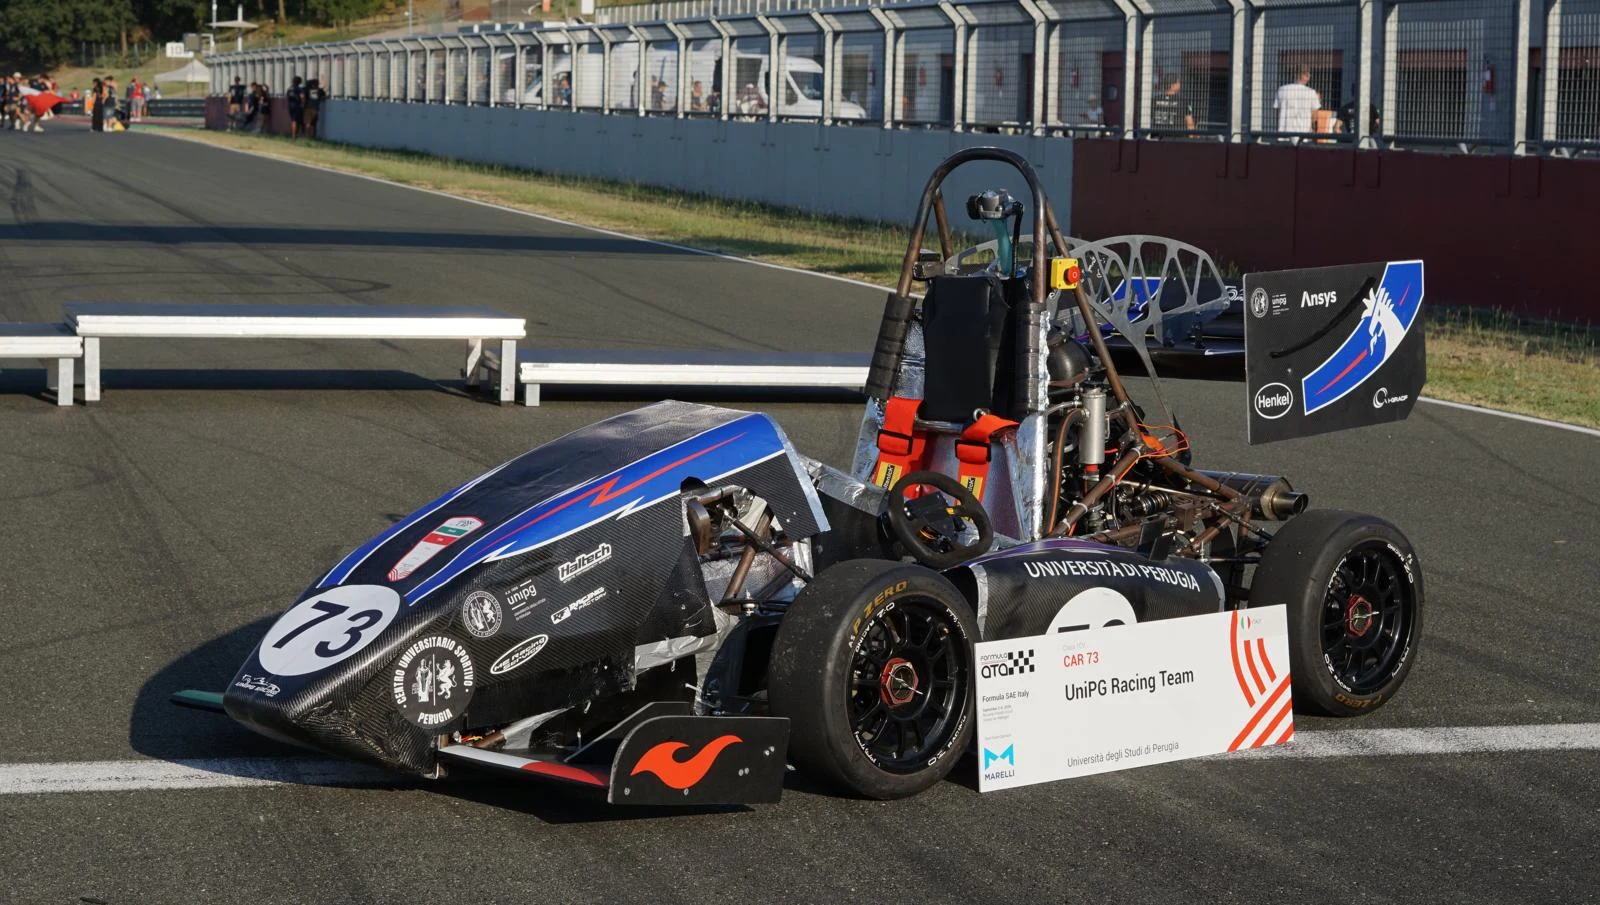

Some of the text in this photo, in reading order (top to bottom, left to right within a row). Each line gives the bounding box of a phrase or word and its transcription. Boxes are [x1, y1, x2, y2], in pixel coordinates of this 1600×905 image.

[1300, 290, 1337, 308] Ansys
[1258, 392, 1290, 409] Henkel
[558, 543, 612, 581] Haltech
[1024, 559, 1201, 592] UNIVERSITÀ DI PERUGIA
[507, 584, 537, 605] unipg
[853, 580, 908, 636] P ZERO
[272, 600, 383, 658] 73
[393, 636, 474, 705] CENTRO UNIVERSITARIO SPORTIVO
[1063, 651, 1099, 667] CAR 73
[982, 689, 1030, 702] Formula SAE Italy
[1065, 670, 1194, 701] UniPG Racing Team
[417, 708, 453, 725] PERUGIA
[1067, 741, 1179, 768] Università degli Studi di Perugia
[984, 769, 1015, 781] MARELLI
